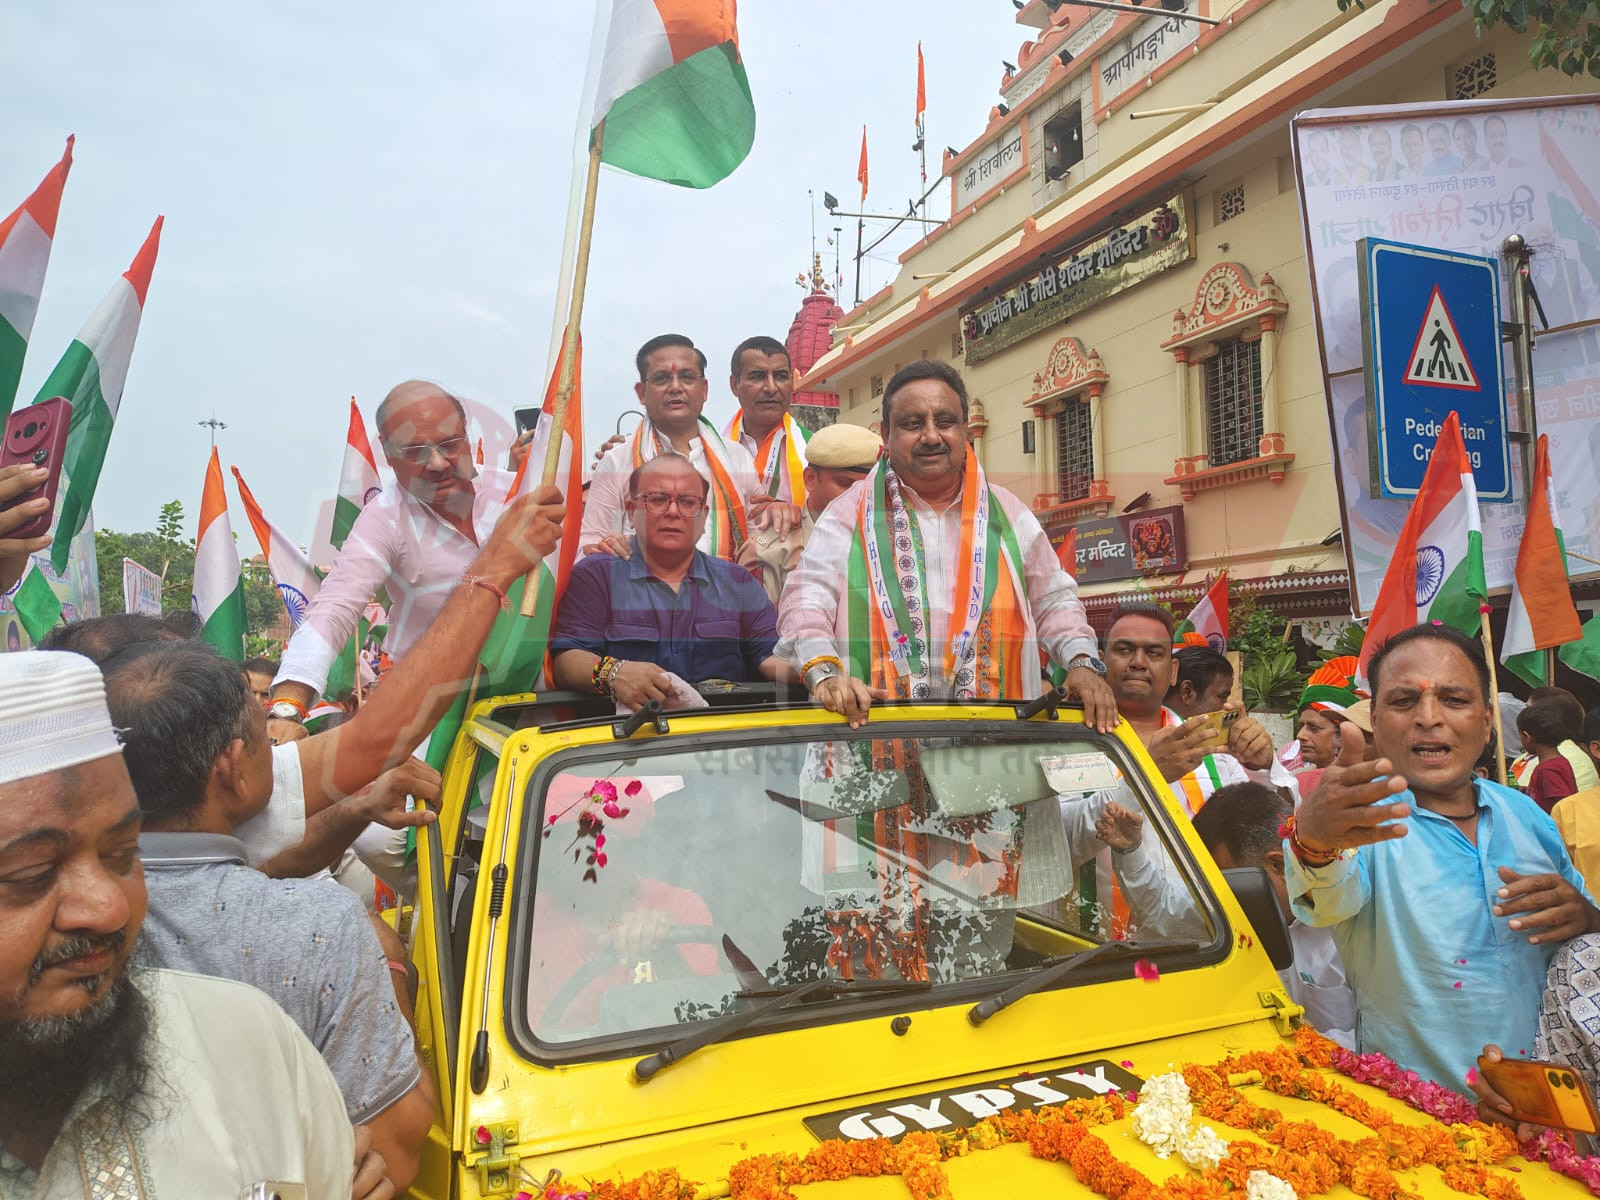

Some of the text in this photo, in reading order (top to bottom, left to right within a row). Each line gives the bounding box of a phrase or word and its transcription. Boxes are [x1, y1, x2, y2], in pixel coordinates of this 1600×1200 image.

[963, 135, 1022, 193] श्री शिवालय
[1013, 283, 1029, 312] श्री
[1405, 417, 1486, 441] Pederian
[1088, 539, 1127, 561] मन्दिर
[969, 546, 985, 620] HIND
[838, 1064, 1122, 1140] GYPSY
